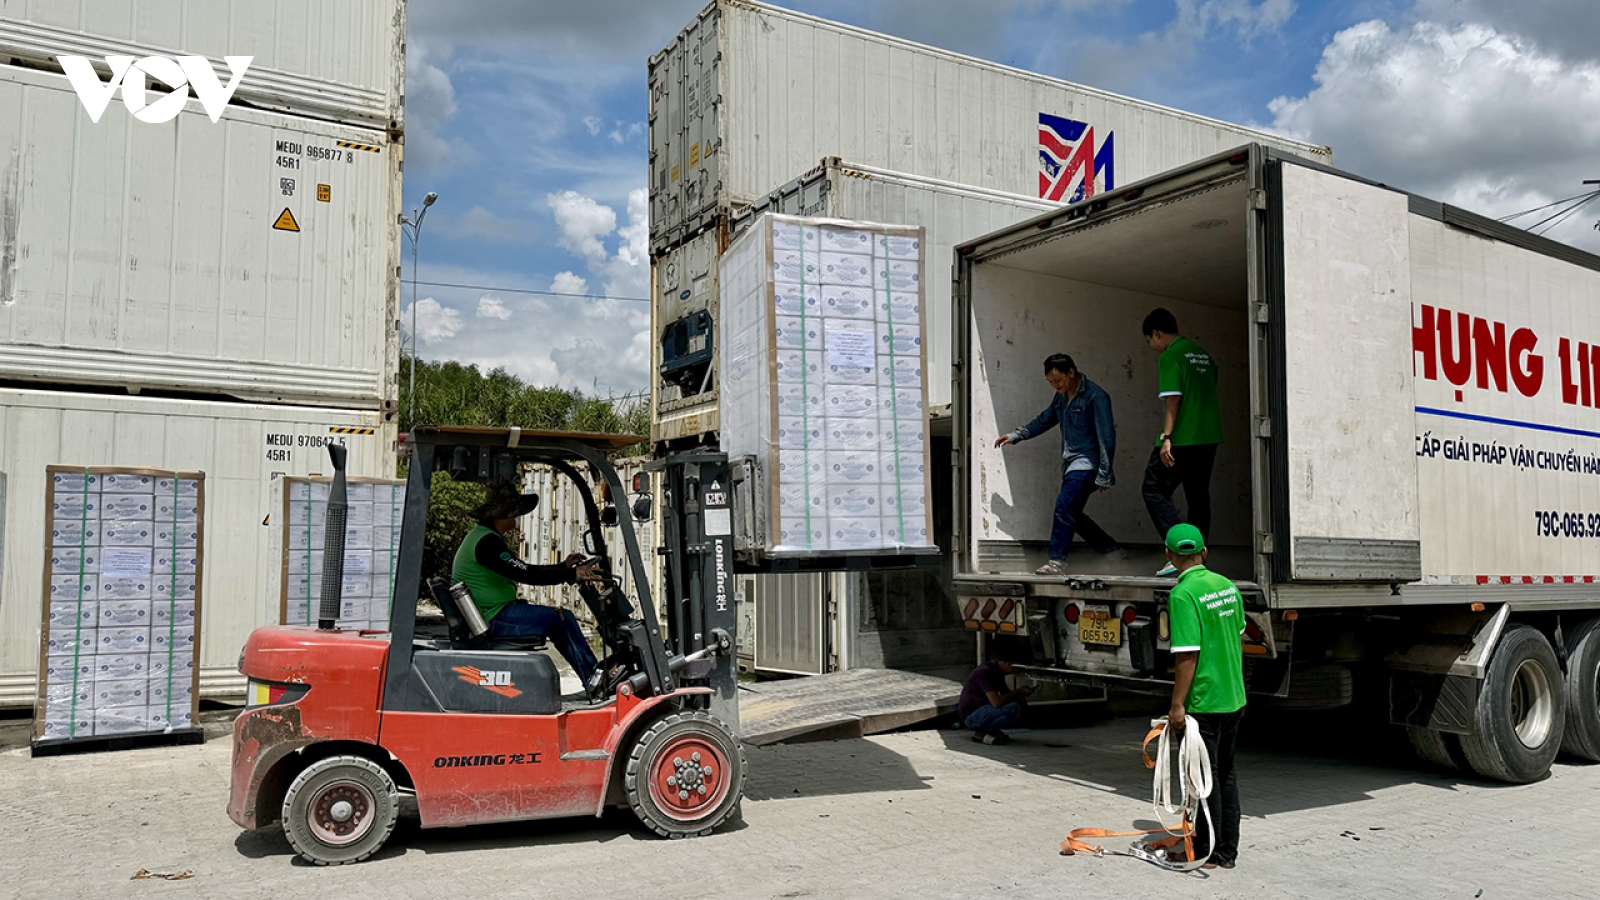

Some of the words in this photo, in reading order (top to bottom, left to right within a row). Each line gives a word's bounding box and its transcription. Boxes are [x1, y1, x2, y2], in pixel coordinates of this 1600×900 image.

[275, 140, 302, 155] MEDU
[306, 145, 342, 161] 965877
[346, 152, 354, 163] 8
[275, 156, 300, 170] 45R1
[266, 433, 293, 447] MEDU
[298, 435, 335, 448] 970647
[266, 449, 291, 461] 45R1
[1443, 435, 1470, 461] GIẢI
[1472, 440, 1507, 465] PHÁP
[1509, 444, 1535, 472] VẬN
[1536, 448, 1581, 474] CHUYỂN
[1535, 510, 1600, 538] 79C-065.92
[1090, 617, 1108, 630] 79C
[1083, 629, 1116, 643] 065.92
[479, 670, 511, 686] 30
[509, 752, 542, 765] 龙工
